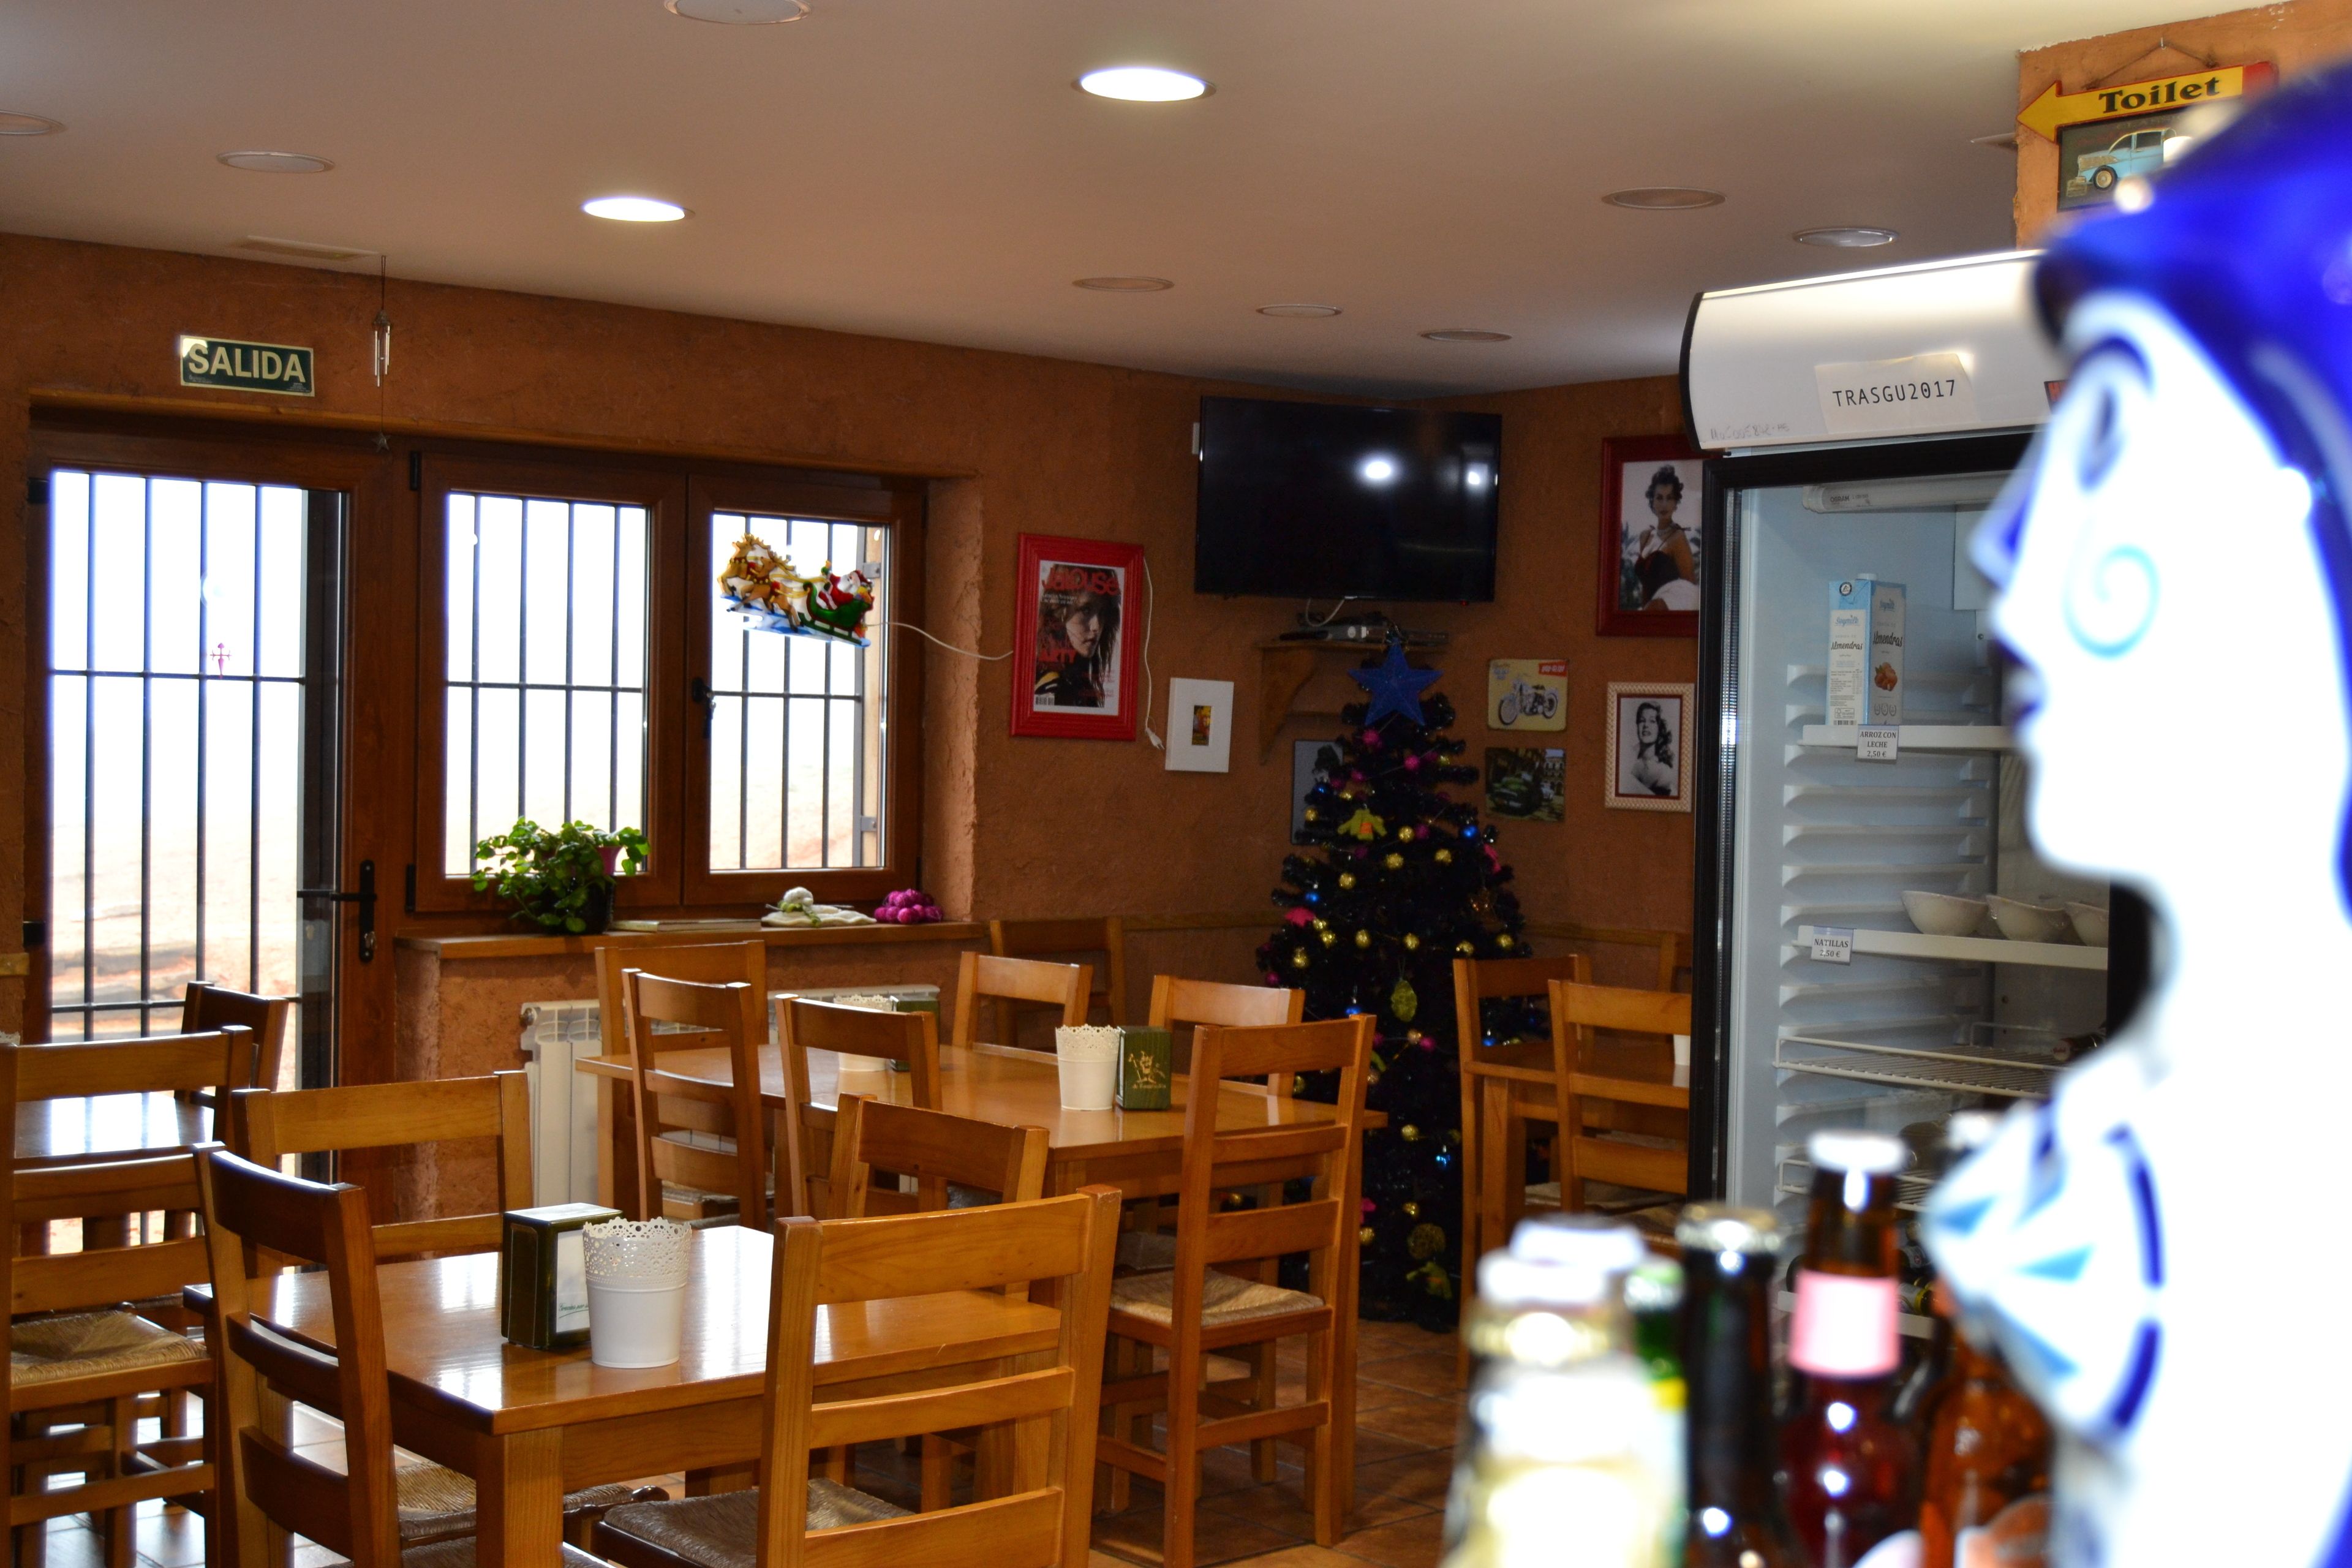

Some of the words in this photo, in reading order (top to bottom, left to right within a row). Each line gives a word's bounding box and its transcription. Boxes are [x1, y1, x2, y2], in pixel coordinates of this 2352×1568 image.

[2098, 78, 2220, 113] Toilet
[189, 344, 306, 383] SALIDA
[1833, 380, 1955, 407] TRASGU2017
[1831, 641, 1863, 650] Almendras
[1872, 631, 1902, 647] Almendras
[1814, 938, 1849, 948] NATILLAS
